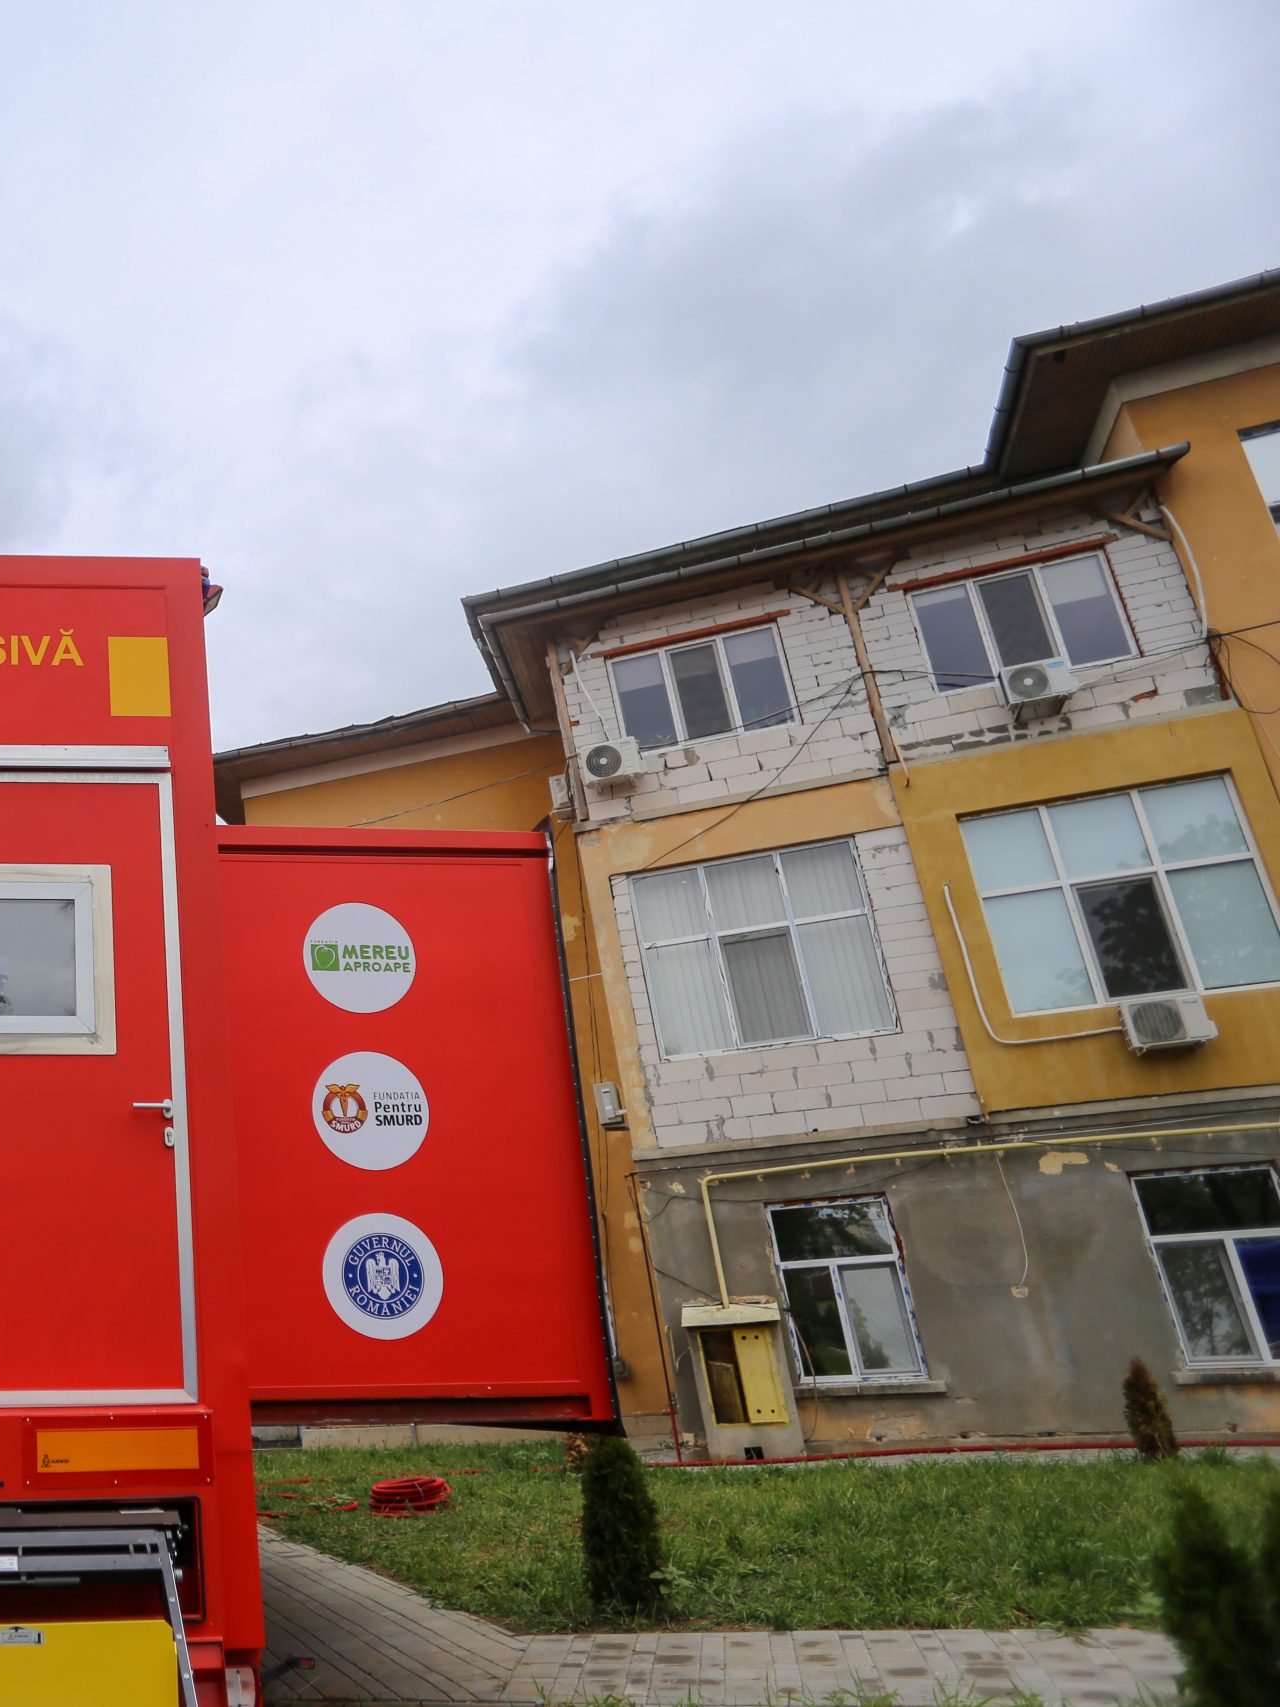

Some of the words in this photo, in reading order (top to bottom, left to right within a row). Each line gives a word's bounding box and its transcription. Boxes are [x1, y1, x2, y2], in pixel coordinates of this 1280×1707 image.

[342, 944, 410, 961] MEREU
[343, 961, 412, 973] APROAPE
[374, 1101, 422, 1113] Pentru
[330, 1120, 361, 1132] SMURD
[375, 1114, 422, 1126] SMURD
[348, 1236, 415, 1267] GUVERNUL
[348, 1284, 420, 1316] ROMÂNIEI
